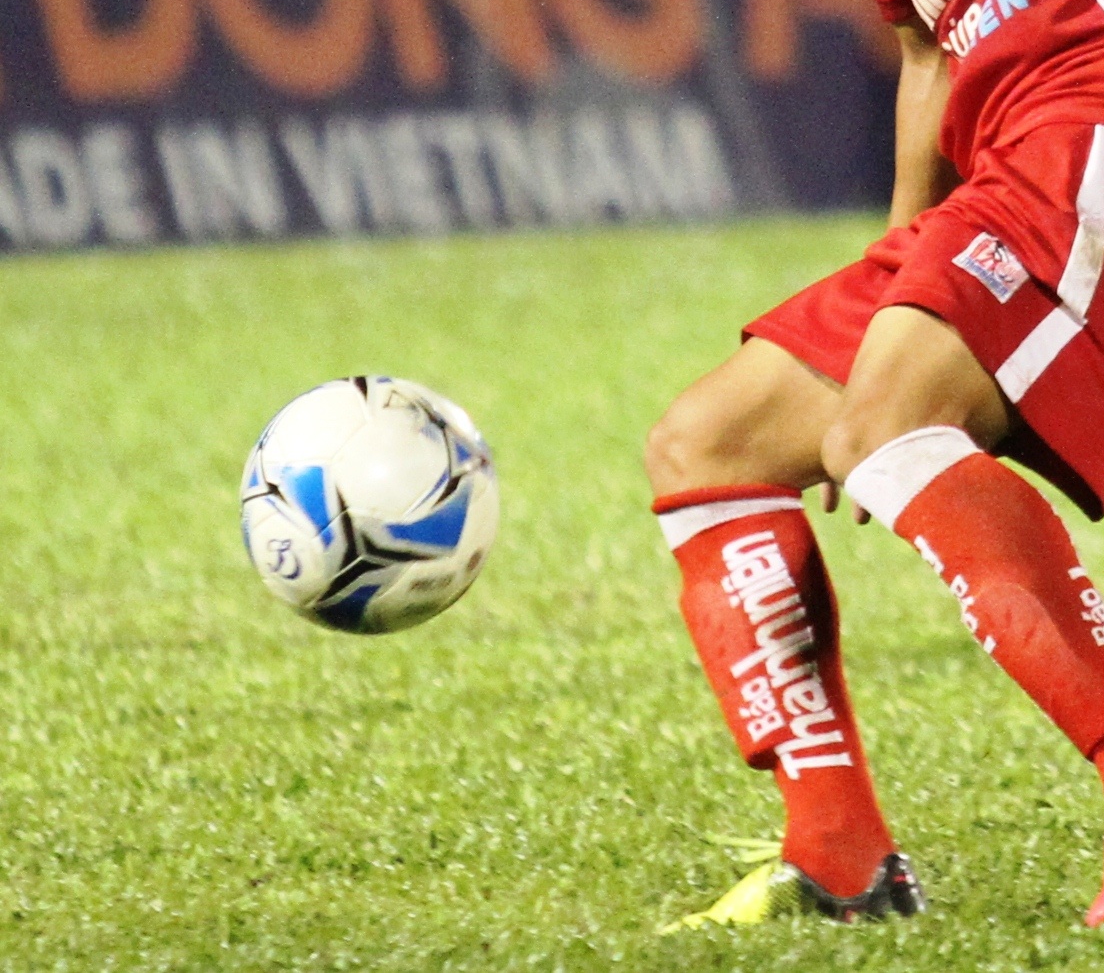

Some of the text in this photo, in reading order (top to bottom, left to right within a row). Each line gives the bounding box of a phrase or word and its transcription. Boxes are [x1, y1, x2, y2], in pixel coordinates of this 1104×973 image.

[155, 119, 291, 235] IN
[280, 100, 736, 230] VIETNAM
[738, 675, 786, 743] Báo
